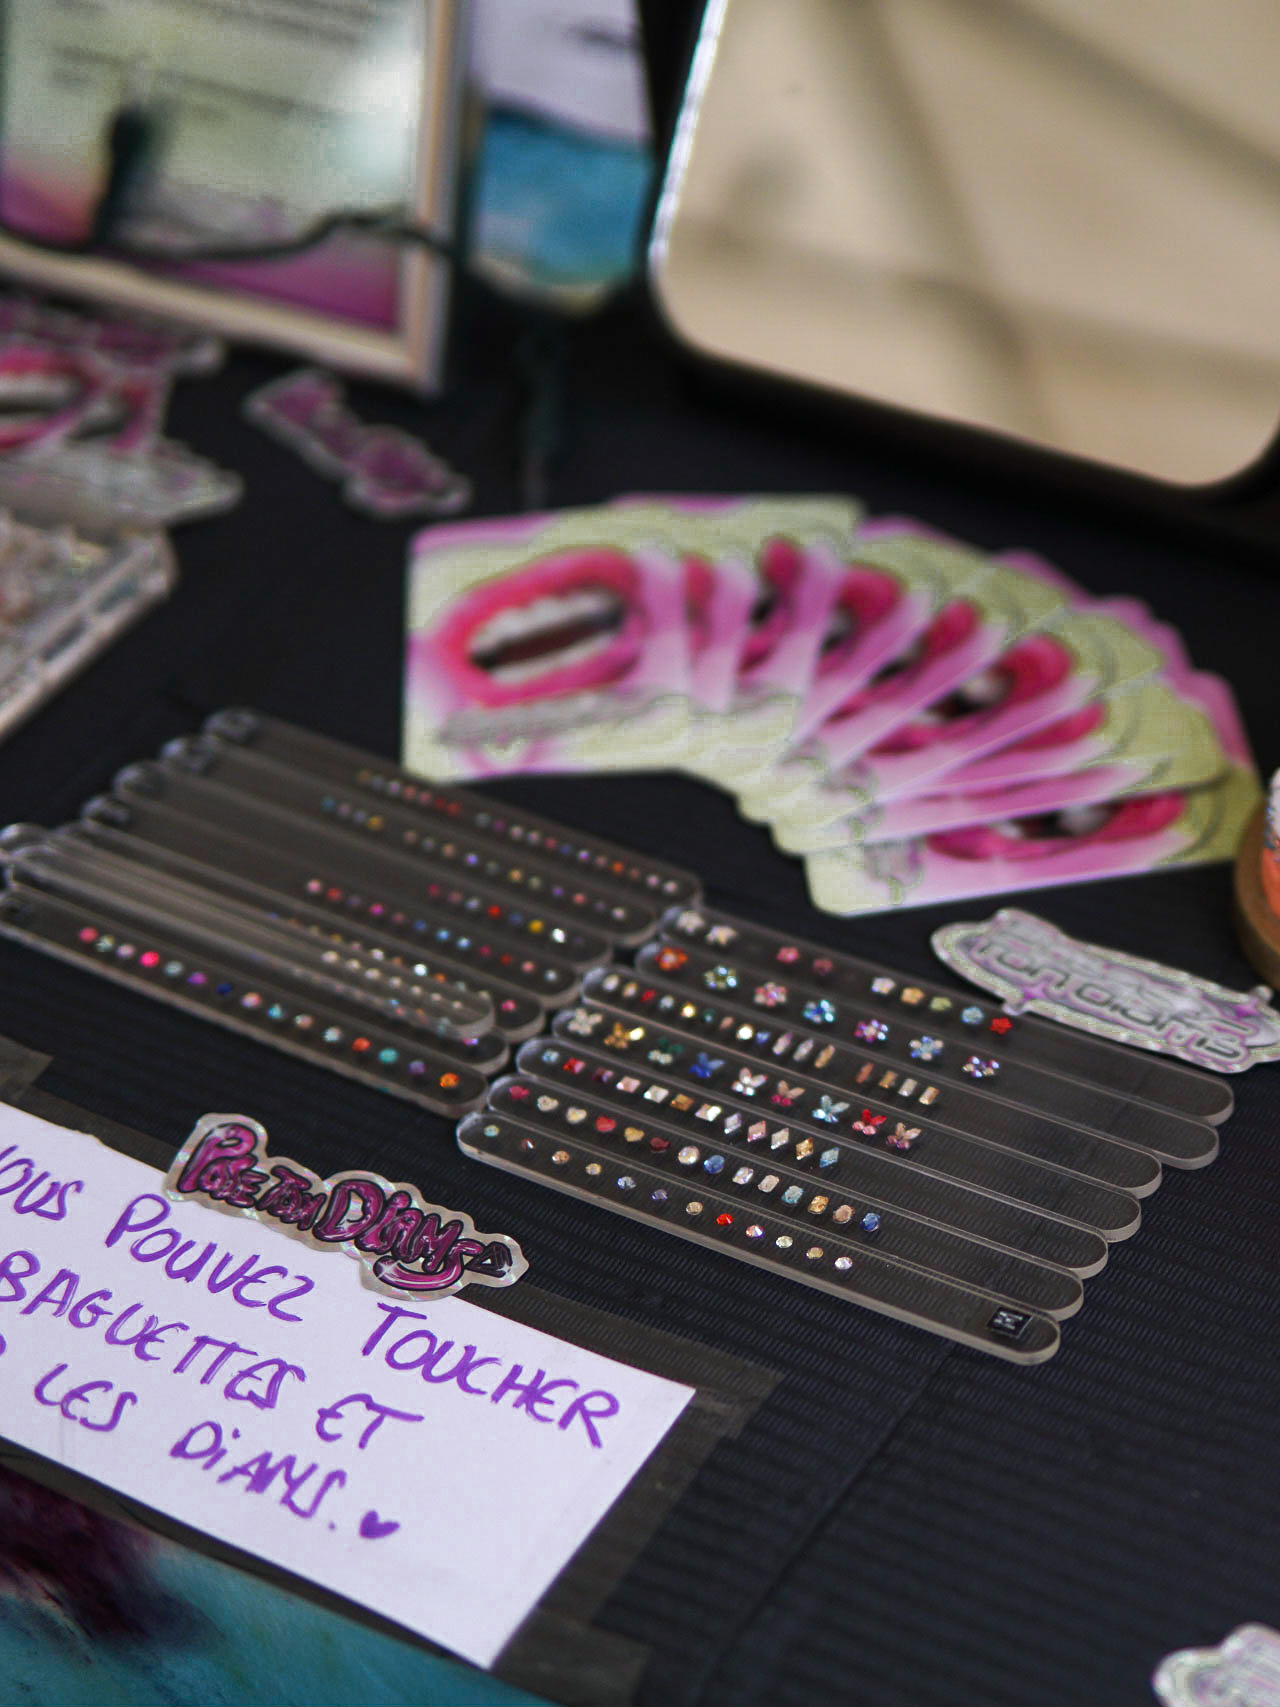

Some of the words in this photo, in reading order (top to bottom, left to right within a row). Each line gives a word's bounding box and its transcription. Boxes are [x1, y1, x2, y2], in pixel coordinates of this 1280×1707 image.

[0, 1250, 307, 1411] BAGUETTES
[315, 1392, 425, 1450] ET
[34, 1363, 138, 1432] LES
[104, 1193, 315, 1322] POUVEZ
[361, 1301, 620, 1450] TOUCHER
